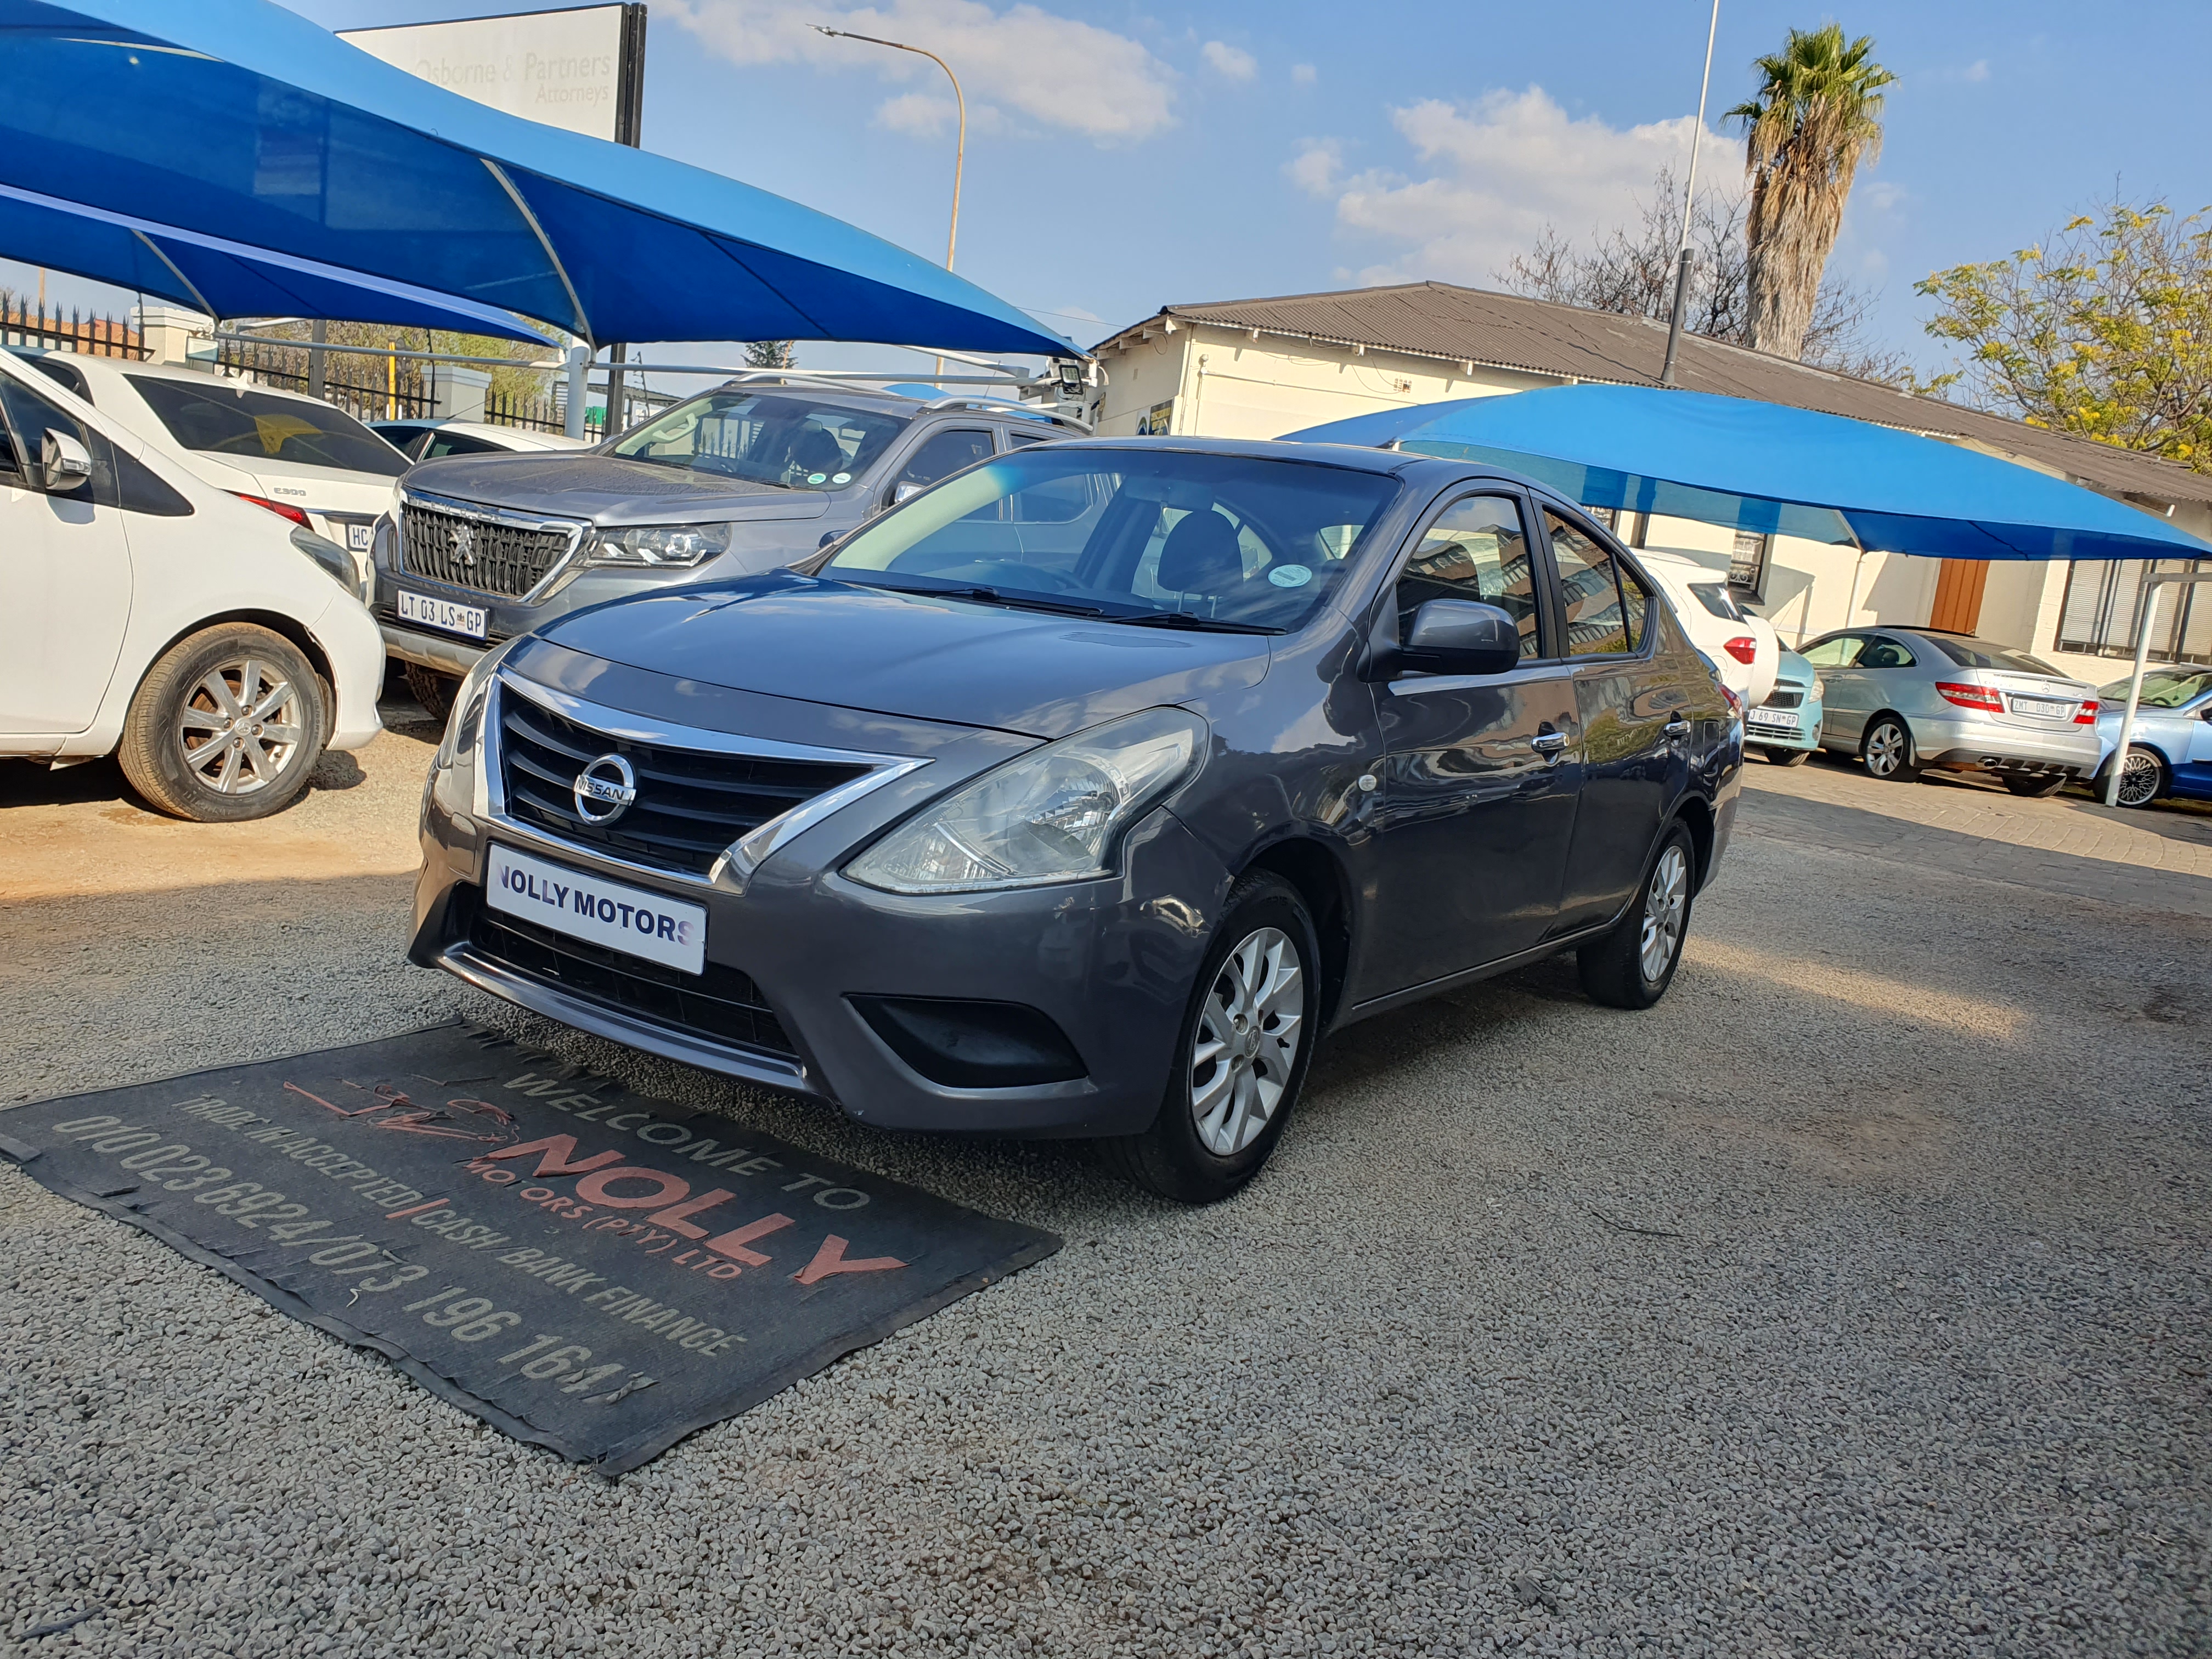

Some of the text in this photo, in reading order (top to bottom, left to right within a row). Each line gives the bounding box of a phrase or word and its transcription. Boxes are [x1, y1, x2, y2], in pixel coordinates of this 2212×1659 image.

[524, 52, 611, 81] Partners
[535, 83, 609, 108] Attorneys
[274, 487, 307, 496] E300
[352, 527, 369, 546] HC
[401, 594, 482, 633] LT 03 LS GP
[1772, 714, 1781, 724] SN
[1786, 715, 1796, 725] GP
[576, 775, 626, 801] NISSAN
[574, 890, 695, 946] MOTORS
[503, 1072, 871, 1210] WELCOME TO
[463, 1159, 594, 1218] MOORS
[672, 1249, 743, 1279] LTD
[472, 1133, 911, 1285] NOLLY
[271, 1137, 426, 1208] ACCEPTED
[583, 1285, 748, 1356] FINANCE
[402, 1285, 522, 1342] 196
